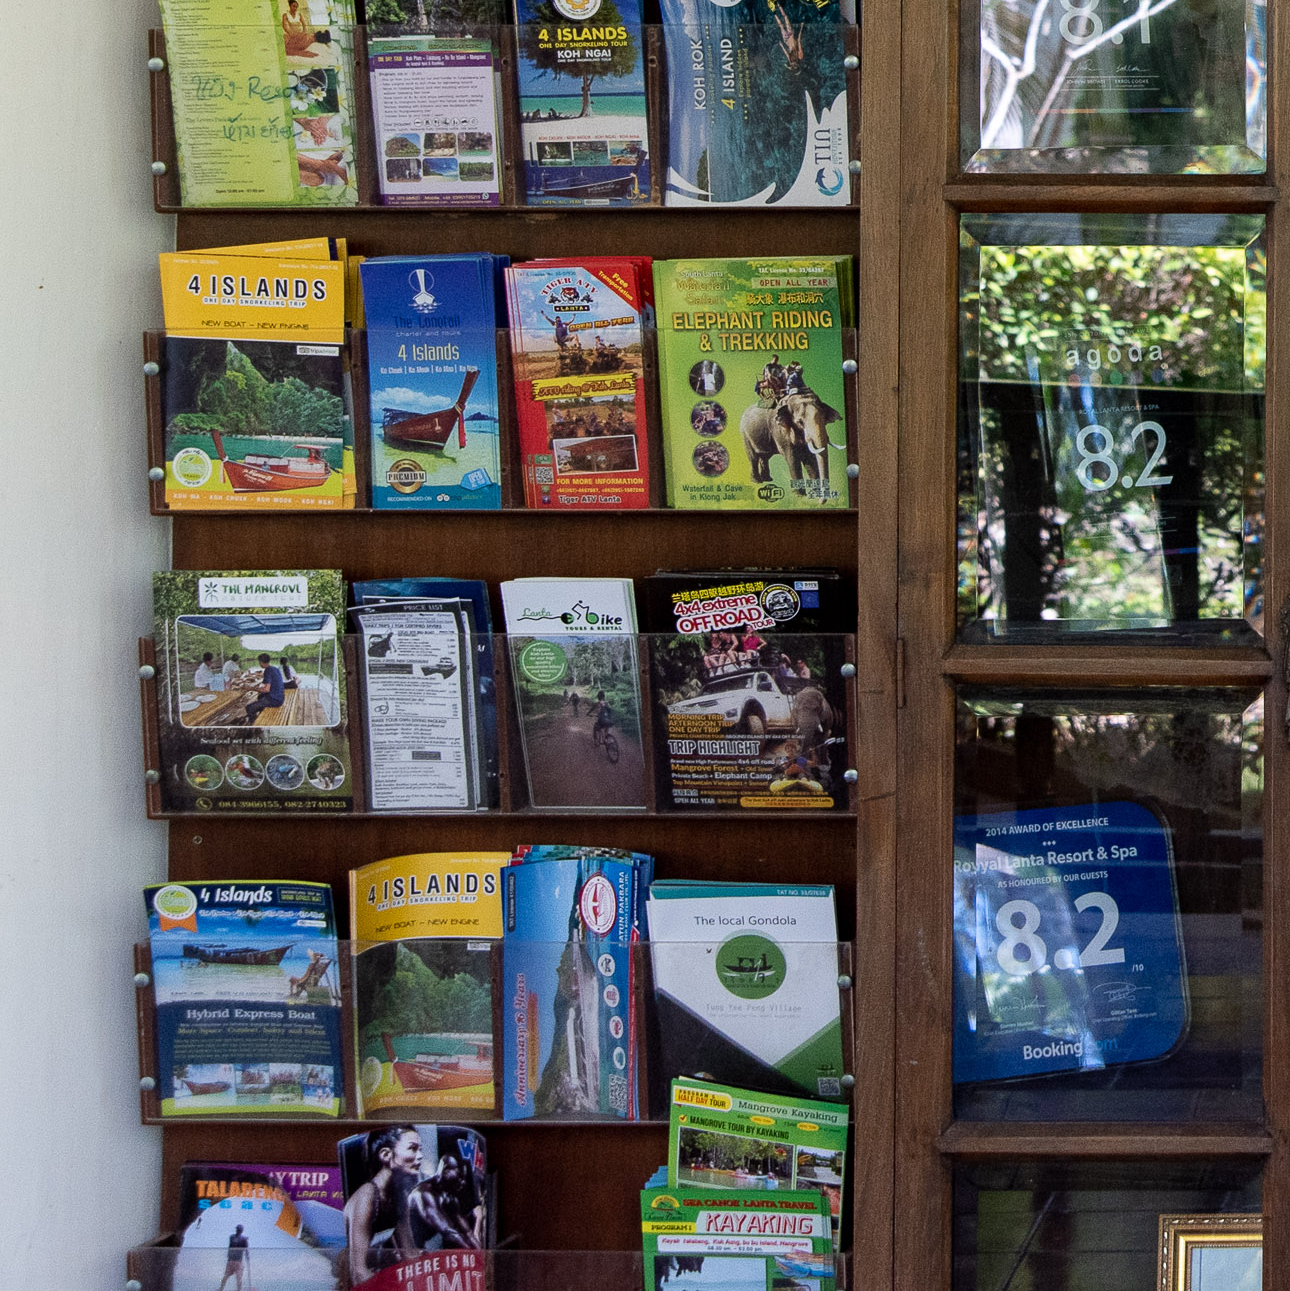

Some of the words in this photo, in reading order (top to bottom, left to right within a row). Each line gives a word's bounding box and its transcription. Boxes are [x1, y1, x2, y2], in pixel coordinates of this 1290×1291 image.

[538, 29, 549, 40] 4
[557, 27, 627, 40] ISLANDS
[557, 50, 580, 59] KOH
[585, 49, 612, 58] NGAI
[690, 39, 704, 72] ROK
[720, 38, 735, 93] ISLAND
[693, 77, 707, 111] KOH
[721, 98, 736, 110] 4
[187, 275, 200, 296] 4
[211, 276, 328, 301] ISLANDS
[759, 279, 781, 287] OPEN
[786, 279, 803, 287] ALL
[807, 279, 828, 287] YEAR
[201, 319, 217, 328] NEW
[218, 320, 245, 329] BOAT
[256, 322, 275, 330] NEW
[276, 323, 309, 331] ENGINE
[672, 310, 764, 332] ELEPHANT
[771, 310, 833, 329] RIDING
[700, 333, 712, 351] &
[718, 331, 809, 351] TREKKING
[397, 344, 408, 361] 4
[412, 343, 460, 361] Islands
[1065, 343, 1163, 369] agoda
[1075, 420, 1174, 492] 8.2
[594, 477, 644, 485] INFORMATION
[558, 495, 579, 504] Tiger
[581, 495, 597, 504] ATV
[599, 495, 622, 504] Lanta
[678, 614, 711, 634] OFF
[711, 609, 763, 628] ROAD
[668, 741, 696, 755] TRIP
[698, 741, 760, 755] HIGHLIGHT
[671, 764, 712, 772] Mangrove
[714, 771, 748, 781] Elephant
[749, 771, 773, 781] Camp
[985, 826, 1008, 837] 2014
[1008, 823, 1041, 835] AWARD
[1042, 823, 1054, 831] OF
[1056, 817, 1109, 829] EXCELLENCE
[367, 887, 376, 905] 4
[382, 873, 496, 901] ISLANDS
[997, 880, 1008, 889] AS
[1008, 875, 1052, 888] HONOURED
[1052, 875, 1062, 883] BY
[1063, 873, 1079, 882] OUR
[1080, 871, 1109, 882] GUESTS
[200, 887, 211, 903] 4
[215, 885, 273, 904] Islands
[693, 915, 716, 926] The
[718, 915, 746, 926] local
[747, 915, 797, 927] Gondola
[995, 891, 1126, 977] 8.2
[1132, 963, 1145, 973] /10
[186, 1008, 230, 1020] Hybrid
[234, 1008, 284, 1020] Express
[288, 1009, 317, 1020] Boat
[738, 1100, 788, 1116] Mangrove
[791, 1109, 839, 1124] Kayaking
[689, 1115, 727, 1131] MANGROVE
[728, 1121, 745, 1133] TOUR
[746, 1125, 756, 1134] BY
[756, 1126, 790, 1140] KAYAKING
[290, 1172, 329, 1187] TRIP
[705, 1212, 813, 1234] KAYAKING
